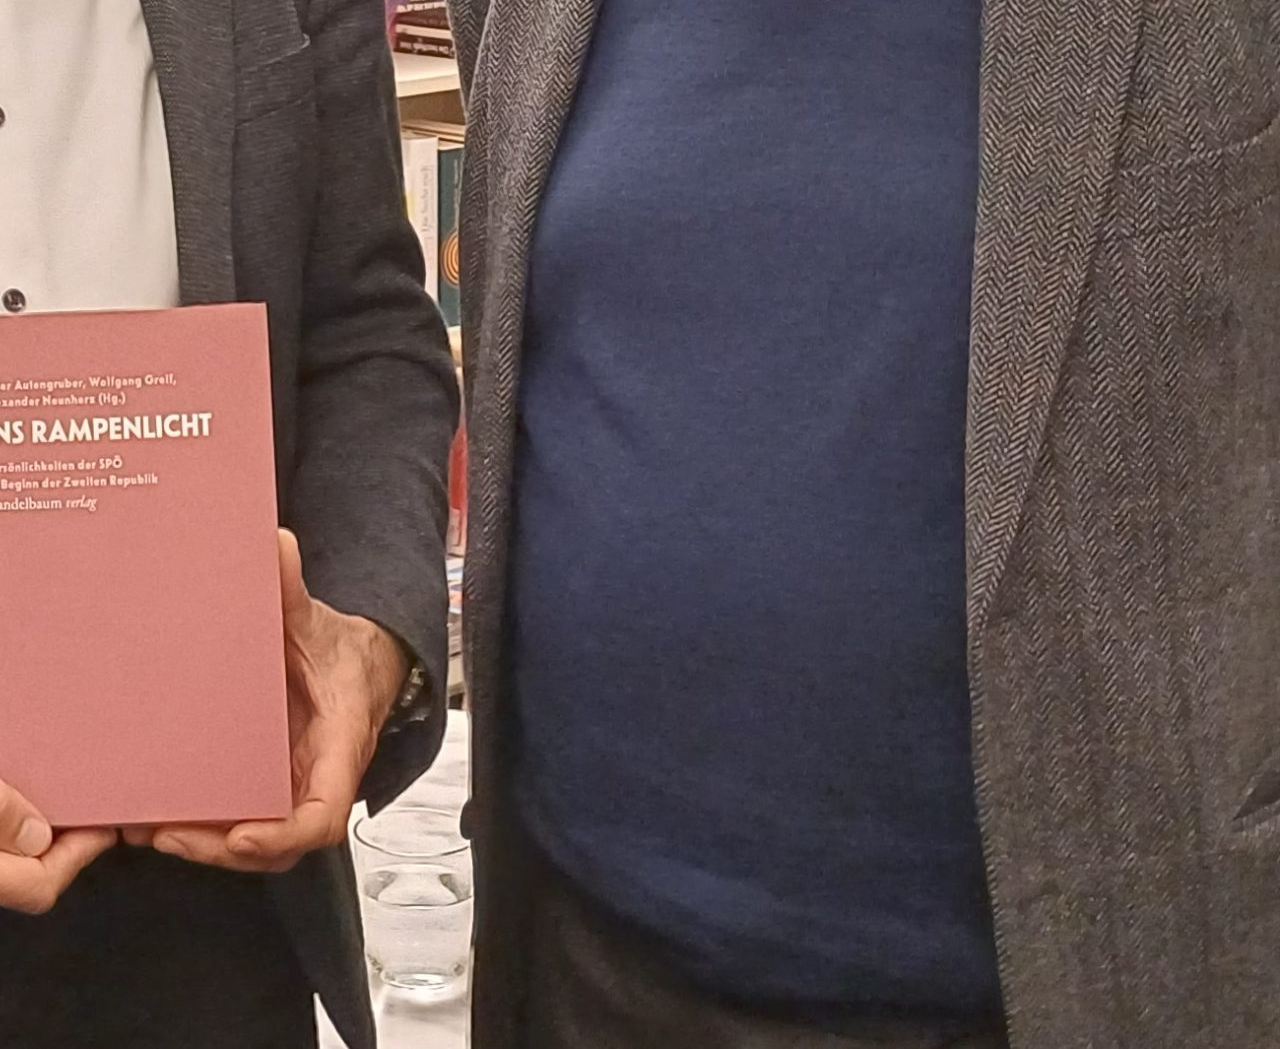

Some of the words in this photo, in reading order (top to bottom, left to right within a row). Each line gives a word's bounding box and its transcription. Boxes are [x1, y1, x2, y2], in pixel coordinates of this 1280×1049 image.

[14, 377, 86, 391] Autengruber,
[88, 375, 142, 390] Wolfgang
[144, 374, 177, 386] Greif,
[42, 393, 95, 406] Neunherz
[98, 393, 126, 407] (Hg.)
[31, 413, 212, 444] RAMPENLICHT
[77, 458, 96, 471] der
[98, 455, 123, 470] SPÖ
[0, 477, 39, 492] Beginn
[41, 476, 61, 489] der
[63, 475, 108, 488] Zweiten
[109, 473, 159, 489] Republik
[65, 495, 98, 513] verlag
